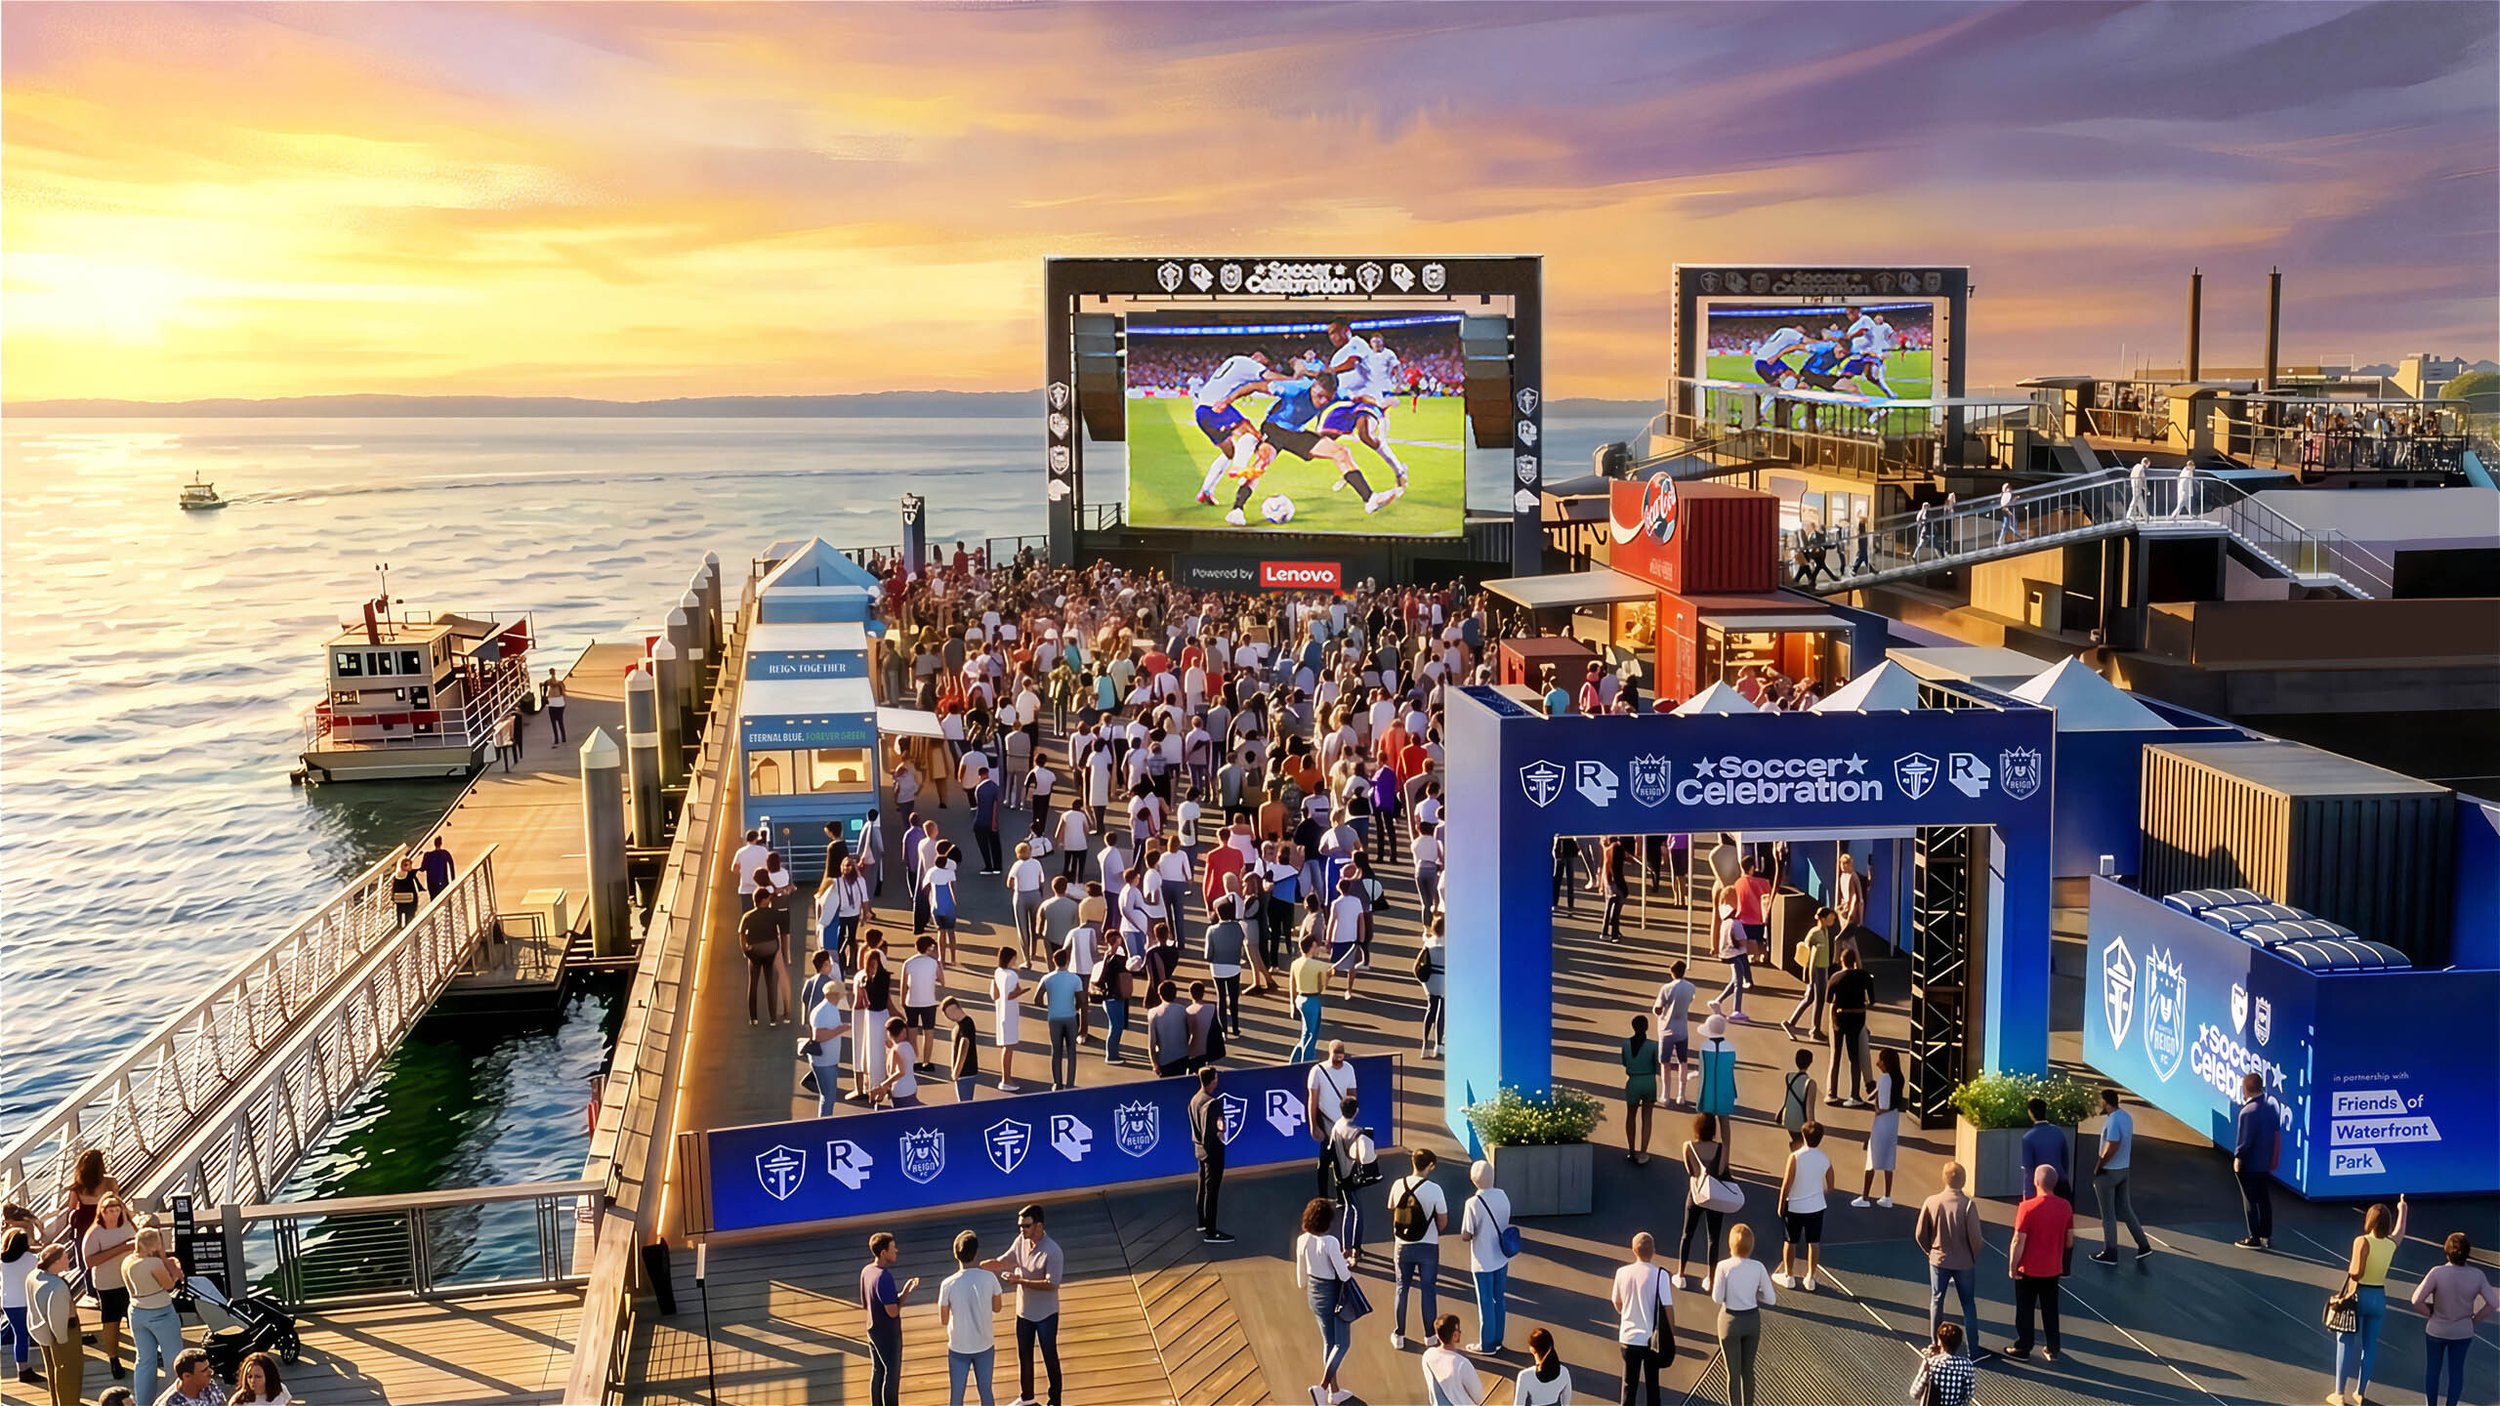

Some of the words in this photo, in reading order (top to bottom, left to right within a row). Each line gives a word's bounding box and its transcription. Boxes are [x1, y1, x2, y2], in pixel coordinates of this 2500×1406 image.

[1192, 568, 1238, 579] Powered
[1239, 568, 1254, 580] by
[1266, 567, 1334, 583] Lenovo
[769, 664, 797, 674] REIGN
[799, 663, 846, 673] TOGETHER
[749, 733, 782, 743] ETERNAL
[806, 731, 839, 741] FOREVER
[840, 730, 866, 740] GREEN
[1719, 755, 1843, 779] Soccer
[1675, 777, 1883, 806] Celebration
[2209, 1025, 2271, 1088] Soccer
[2333, 1074, 2341, 1082] in
[2343, 1072, 2390, 1083] partnership
[2392, 1071, 2409, 1080] with
[2338, 1095, 2397, 1111] Friends
[2407, 1094, 2424, 1108] of
[2336, 1122, 2429, 1140] Waterfront
[1127, 1135, 1150, 1146] REIGN
[912, 1162, 936, 1173] REIGN
[2336, 1153, 2373, 1169] Park
